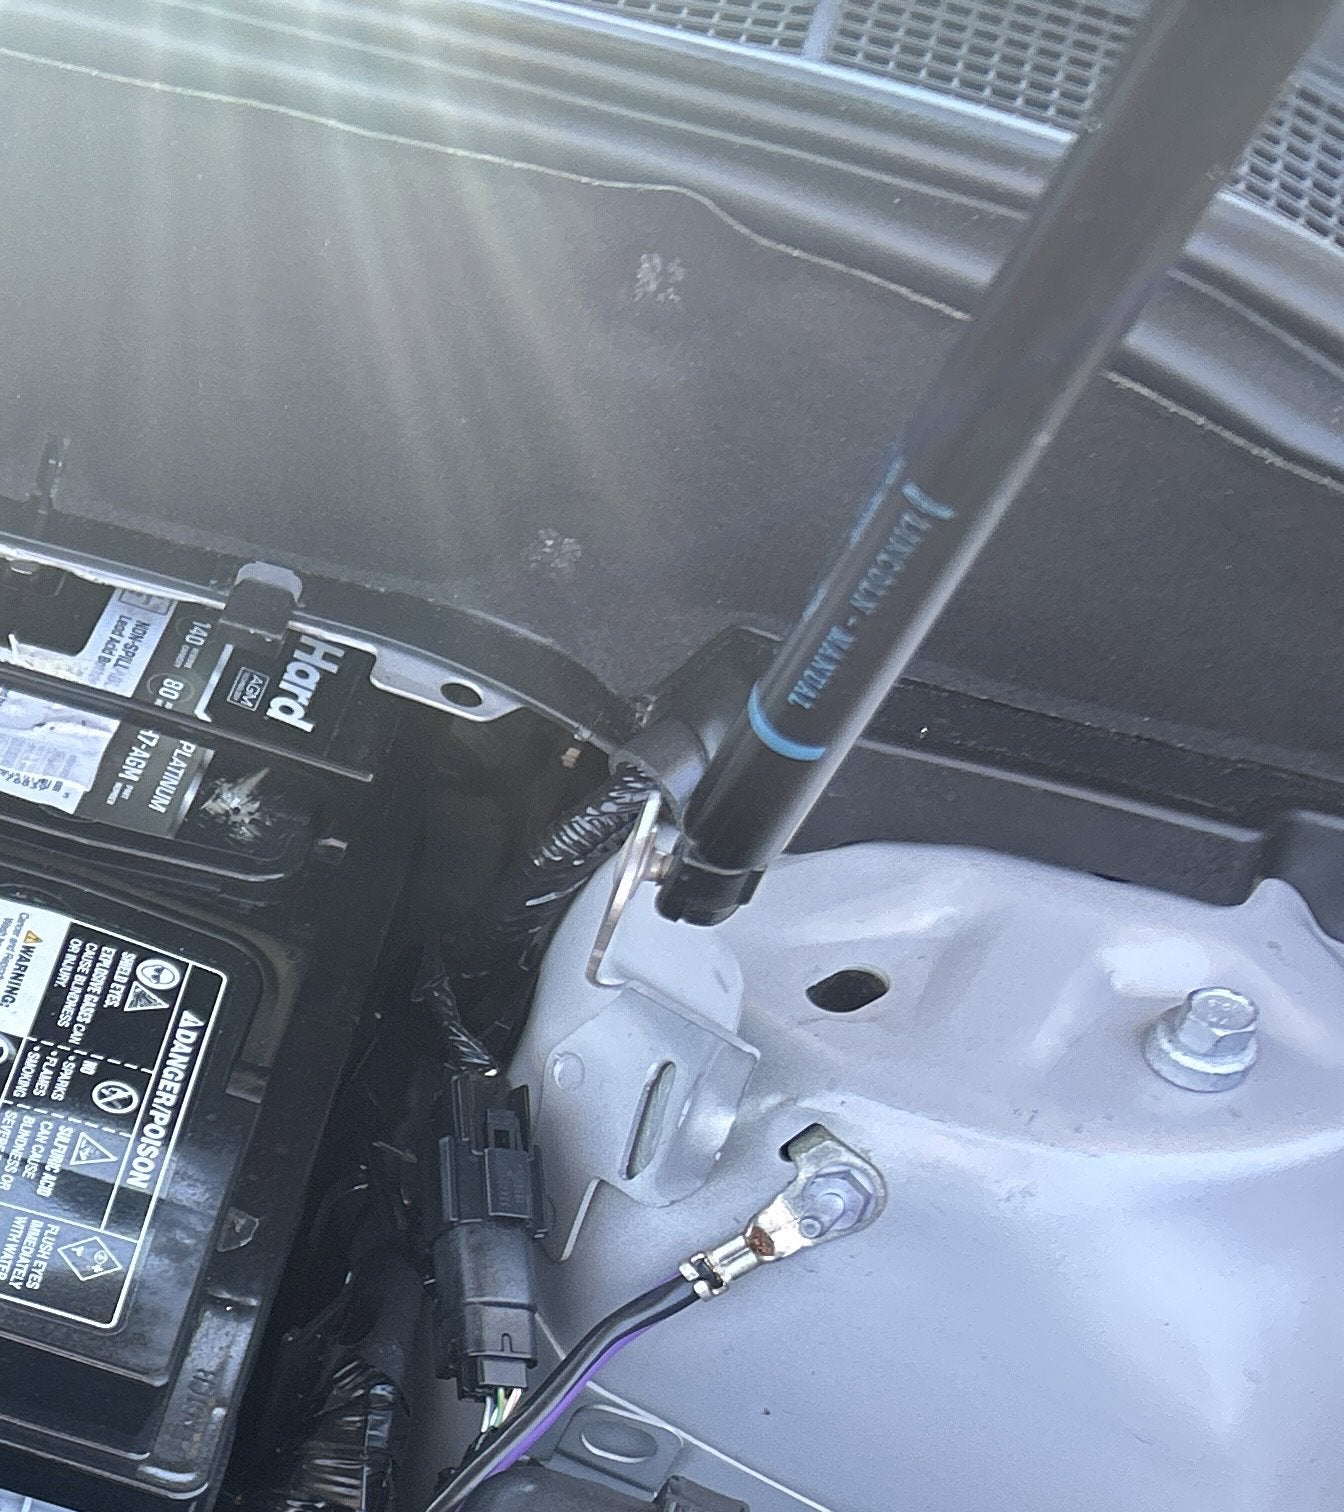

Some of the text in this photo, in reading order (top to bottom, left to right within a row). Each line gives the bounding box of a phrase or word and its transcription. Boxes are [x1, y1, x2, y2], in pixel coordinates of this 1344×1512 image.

[101, 614, 132, 656] Lead Acid
[183, 619, 211, 646] 140
[156, 676, 184, 701] 80
[238, 672, 266, 708] AGM
[262, 633, 346, 732] Hard
[147, 738, 196, 814] PLATINUM
[52, 936, 83, 990] OR INJURY.
[55, 941, 98, 1029] CAUSE BLINDNESS
[86, 945, 116, 995] EXPLOSIVE
[112, 950, 136, 984] SHIELD
[67, 1022, 86, 1045] CAN
[12, 1050, 40, 1099] SMOKING
[31, 1055, 58, 1098] FLAMES
[49, 1059, 76, 1102] SPARKS
[78, 1058, 98, 1076] NO
[126, 1025, 197, 1189] DANGER/POISON
[2, 1114, 35, 1174] BLINDNESS
[20, 1119, 53, 1180] CAN CAUSE
[34, 1124, 73, 1198] SULFURIC ACID
[6, 1213, 27, 1243] WITH
[6, 1217, 43, 1290] IMMEDIATELY
[24, 1222, 59, 1290] FLUSH EYES
